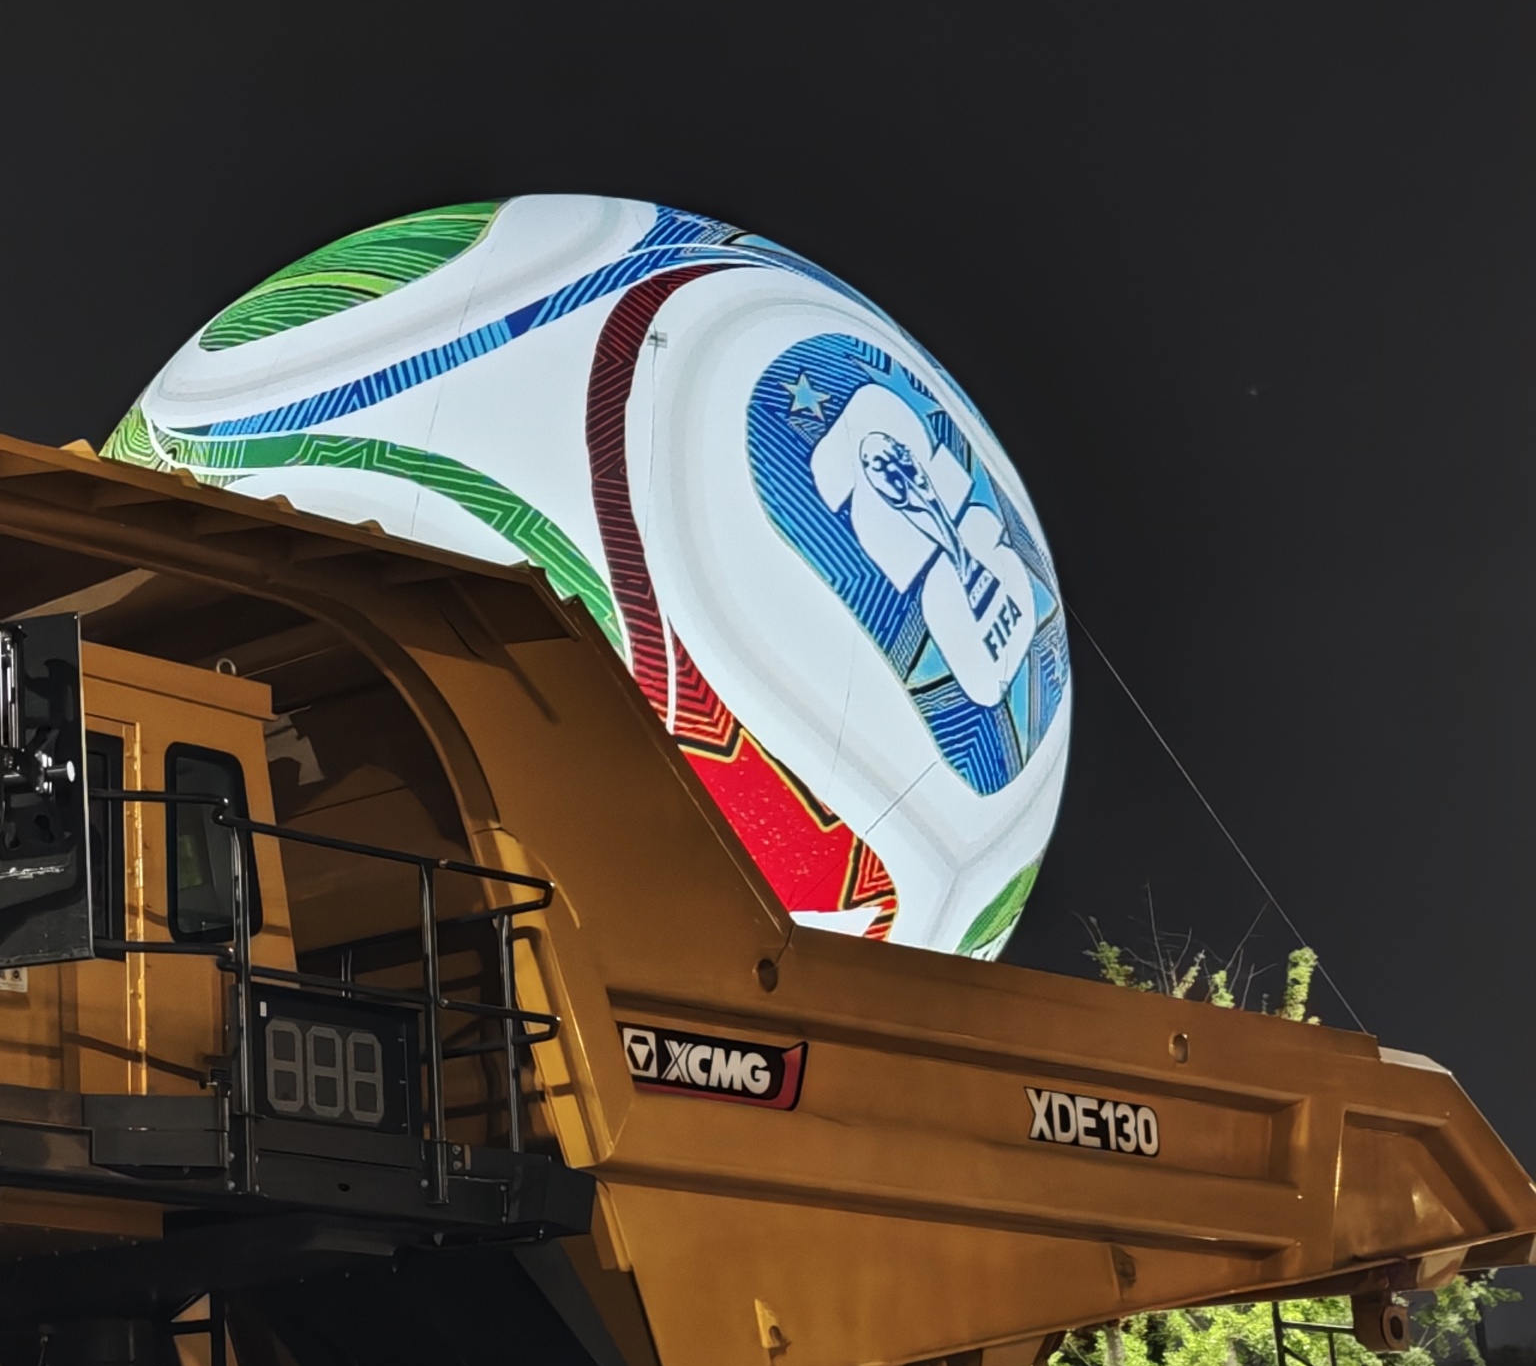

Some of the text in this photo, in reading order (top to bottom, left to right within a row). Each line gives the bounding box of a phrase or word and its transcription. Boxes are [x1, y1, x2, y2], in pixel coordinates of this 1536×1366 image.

[982, 593, 1023, 663] FIFA
[661, 1039, 771, 1095] XCMG
[1025, 1087, 1159, 1156] XDE130
